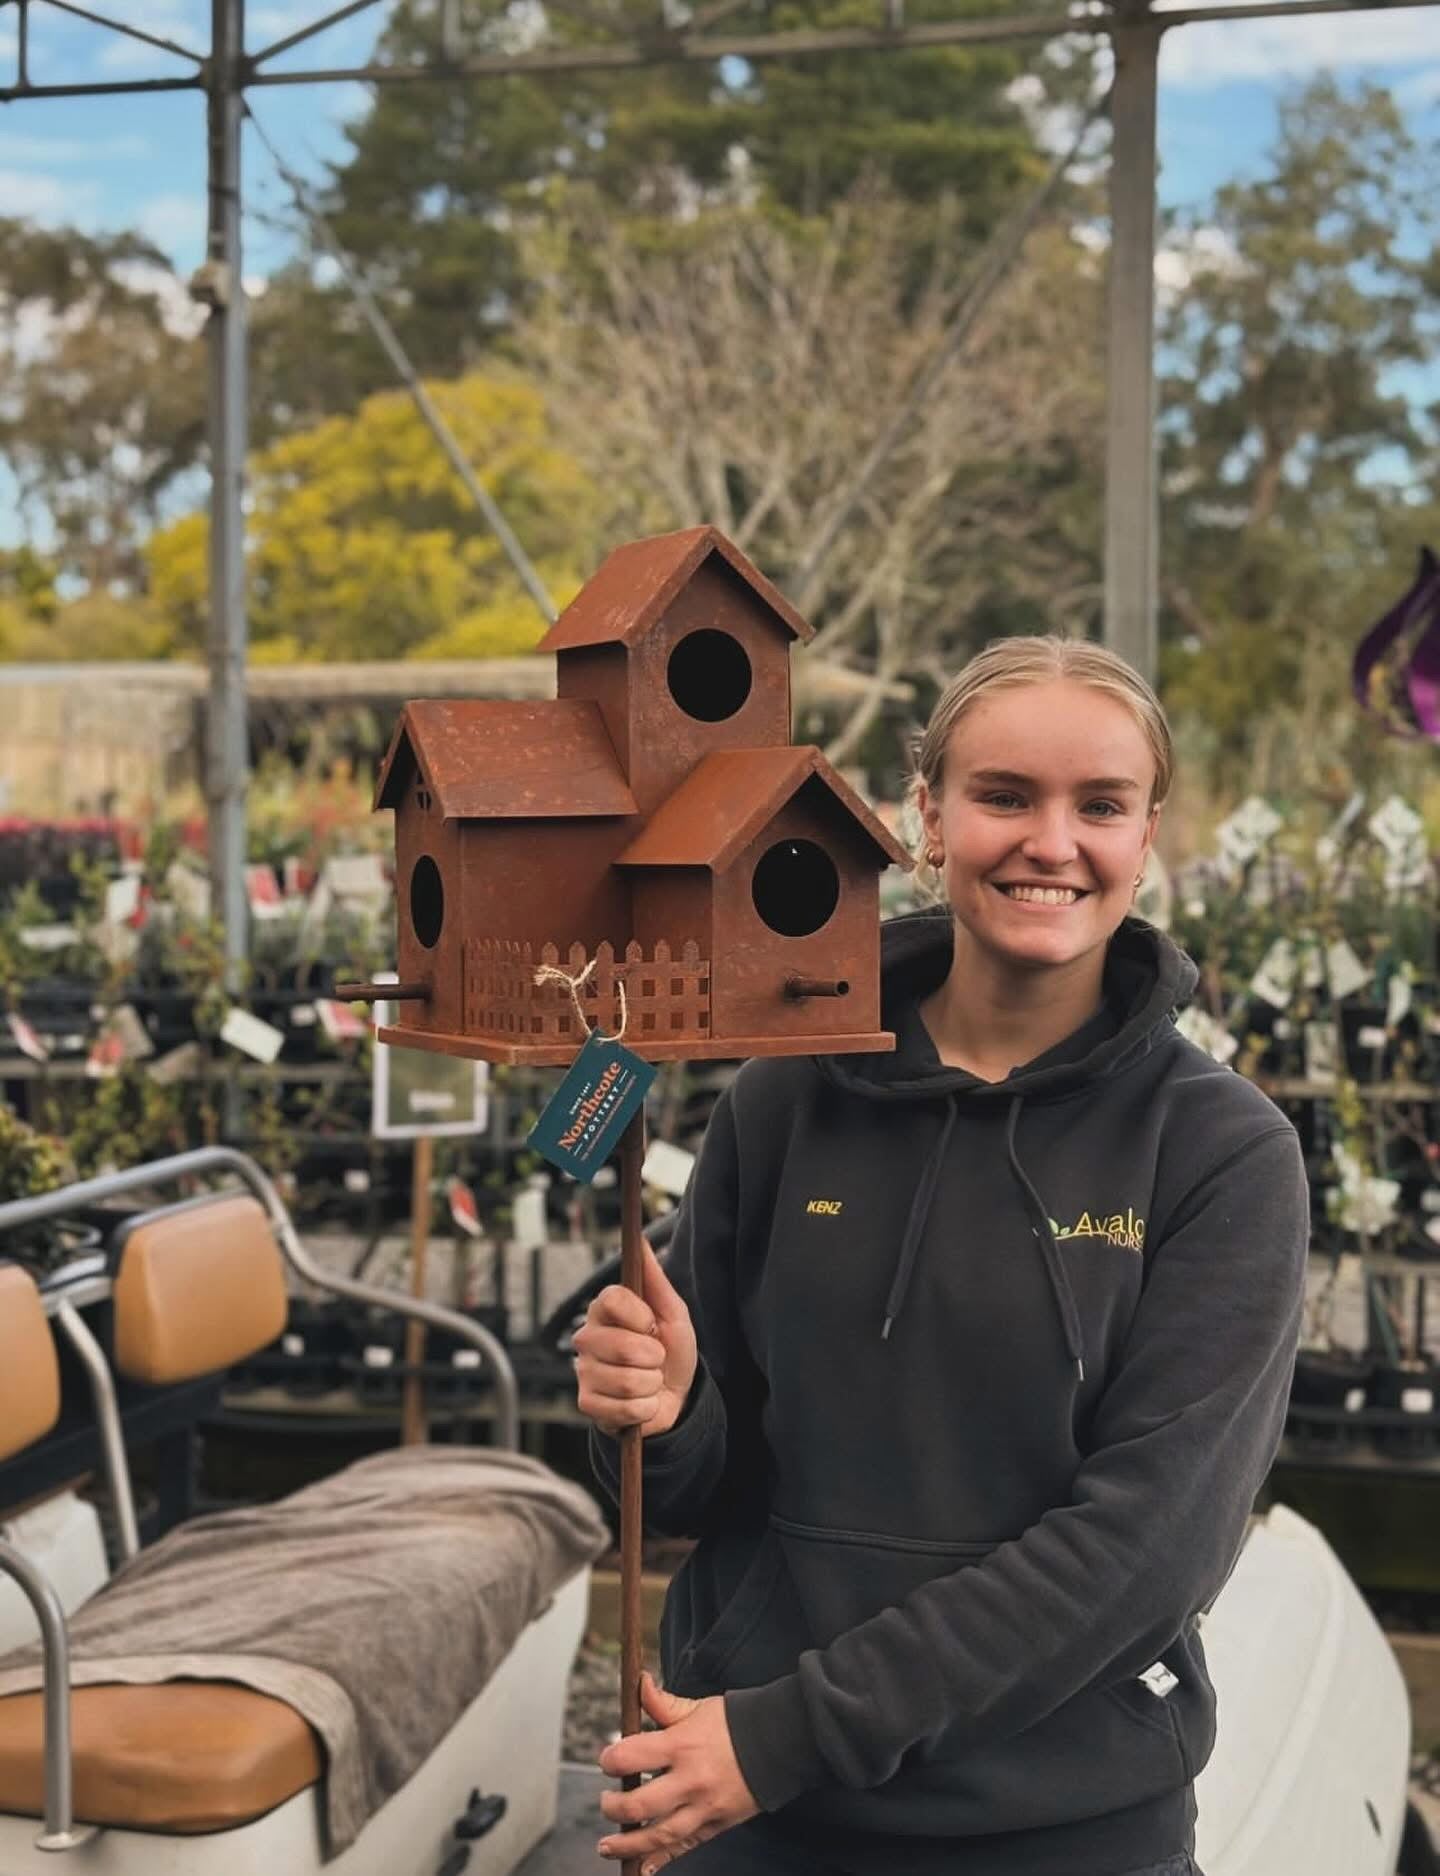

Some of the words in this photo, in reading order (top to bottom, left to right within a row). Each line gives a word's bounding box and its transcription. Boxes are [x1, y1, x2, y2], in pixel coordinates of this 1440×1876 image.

[558, 1062, 622, 1151] Northcote
[583, 1086, 619, 1140] POTTERY
[806, 1200, 842, 1215] KENZ
